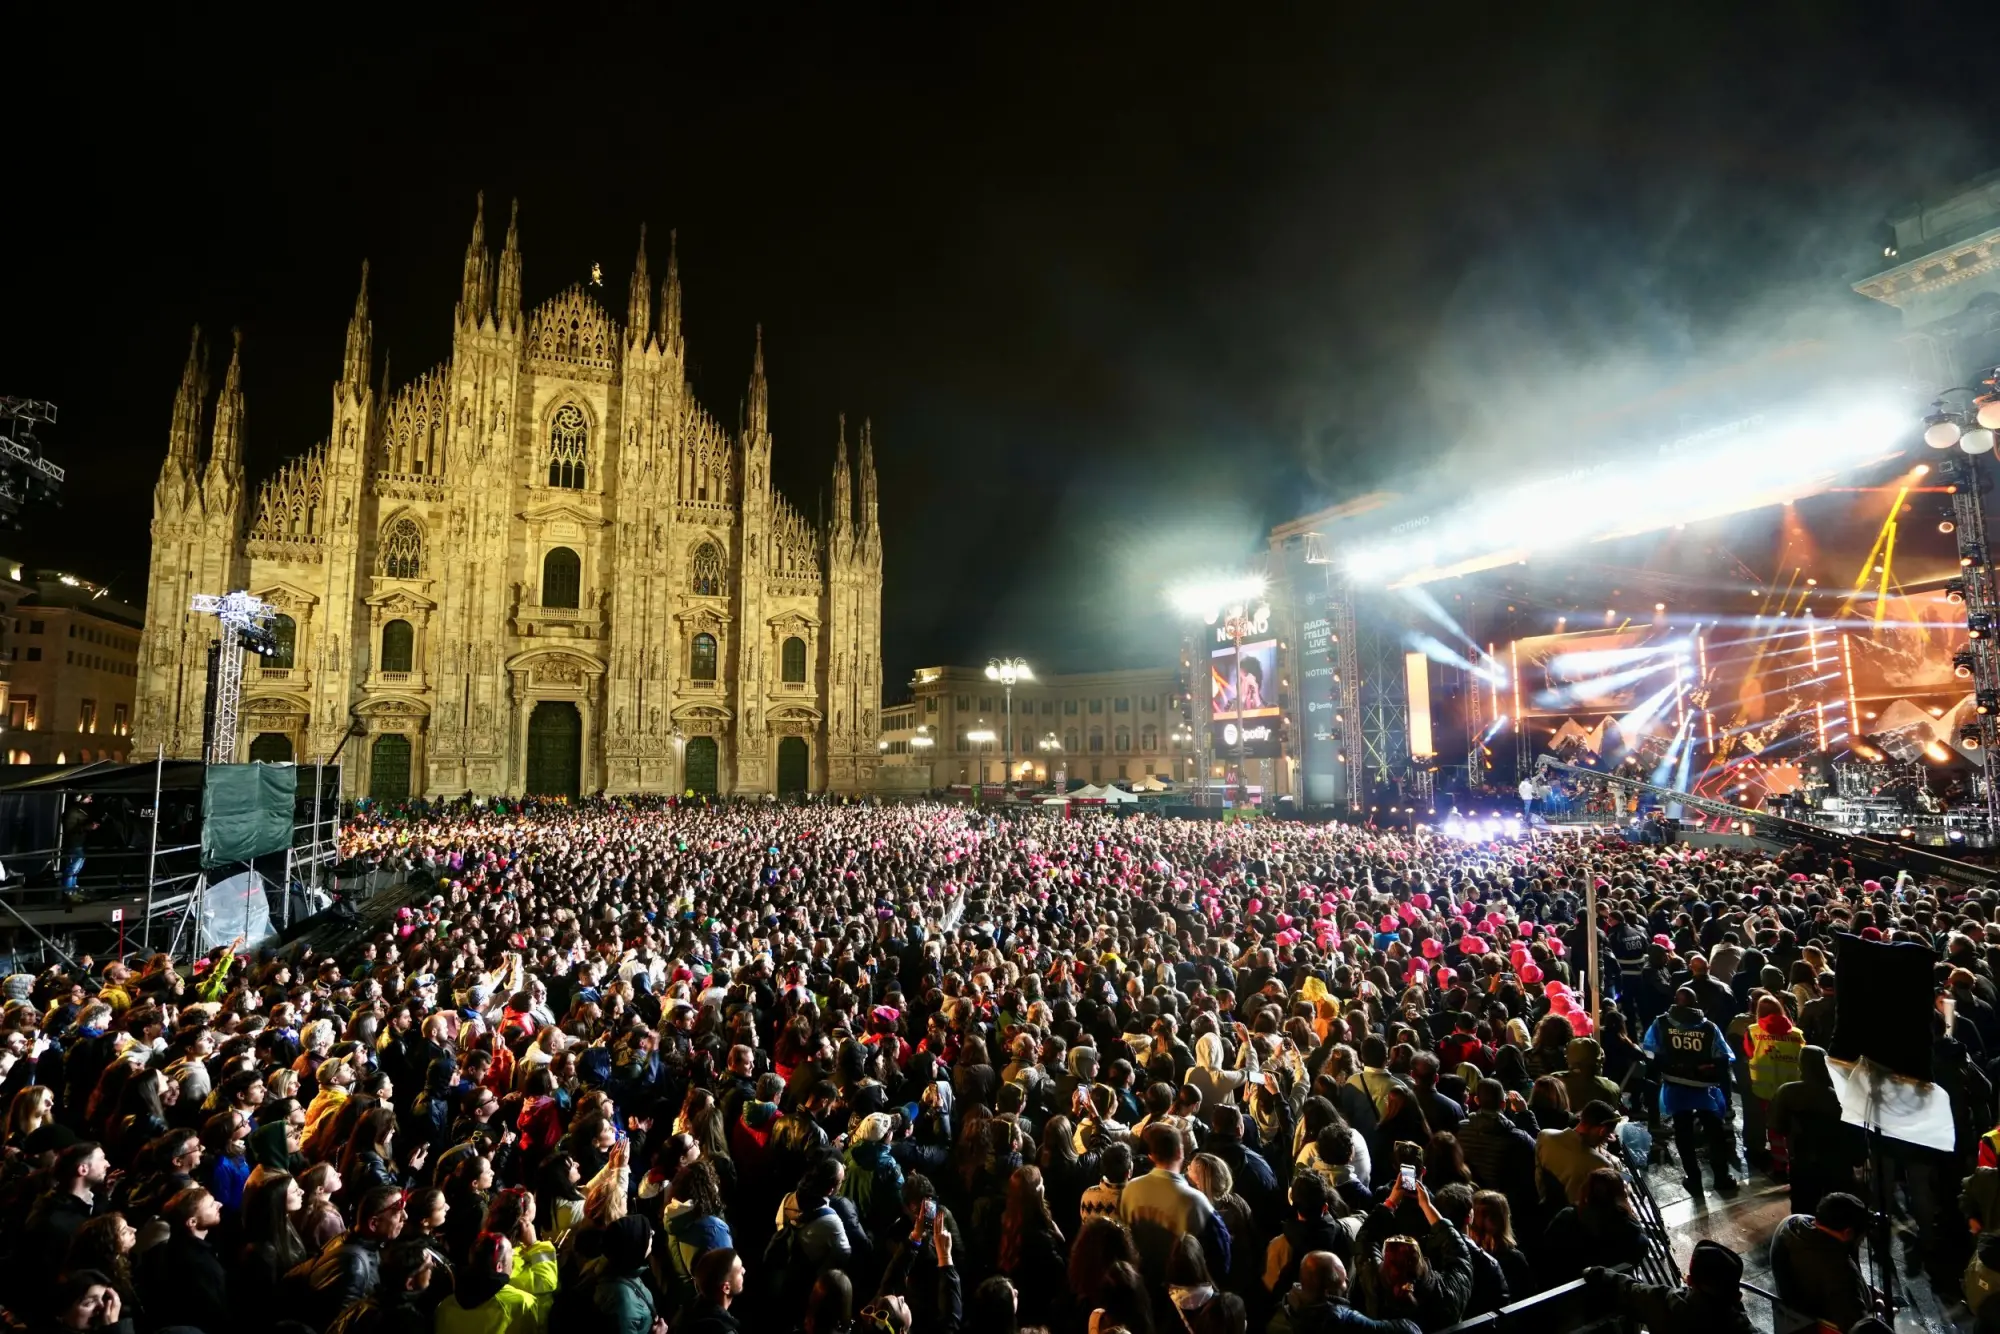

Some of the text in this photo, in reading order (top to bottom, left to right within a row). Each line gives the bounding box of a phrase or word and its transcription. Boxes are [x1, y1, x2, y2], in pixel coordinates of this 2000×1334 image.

[1391, 515, 1430, 534] NOTINO
[1216, 619, 1269, 642] NOINO
[1303, 627, 1332, 640] ITALIA
[1309, 638, 1327, 648] LIVE
[1305, 667, 1334, 678] NOTINO
[1317, 702, 1333, 710] Spotify
[1625, 940, 1642, 950] 080
[1668, 1028, 1704, 1038] SECURITY
[1672, 1035, 1702, 1051] 050
